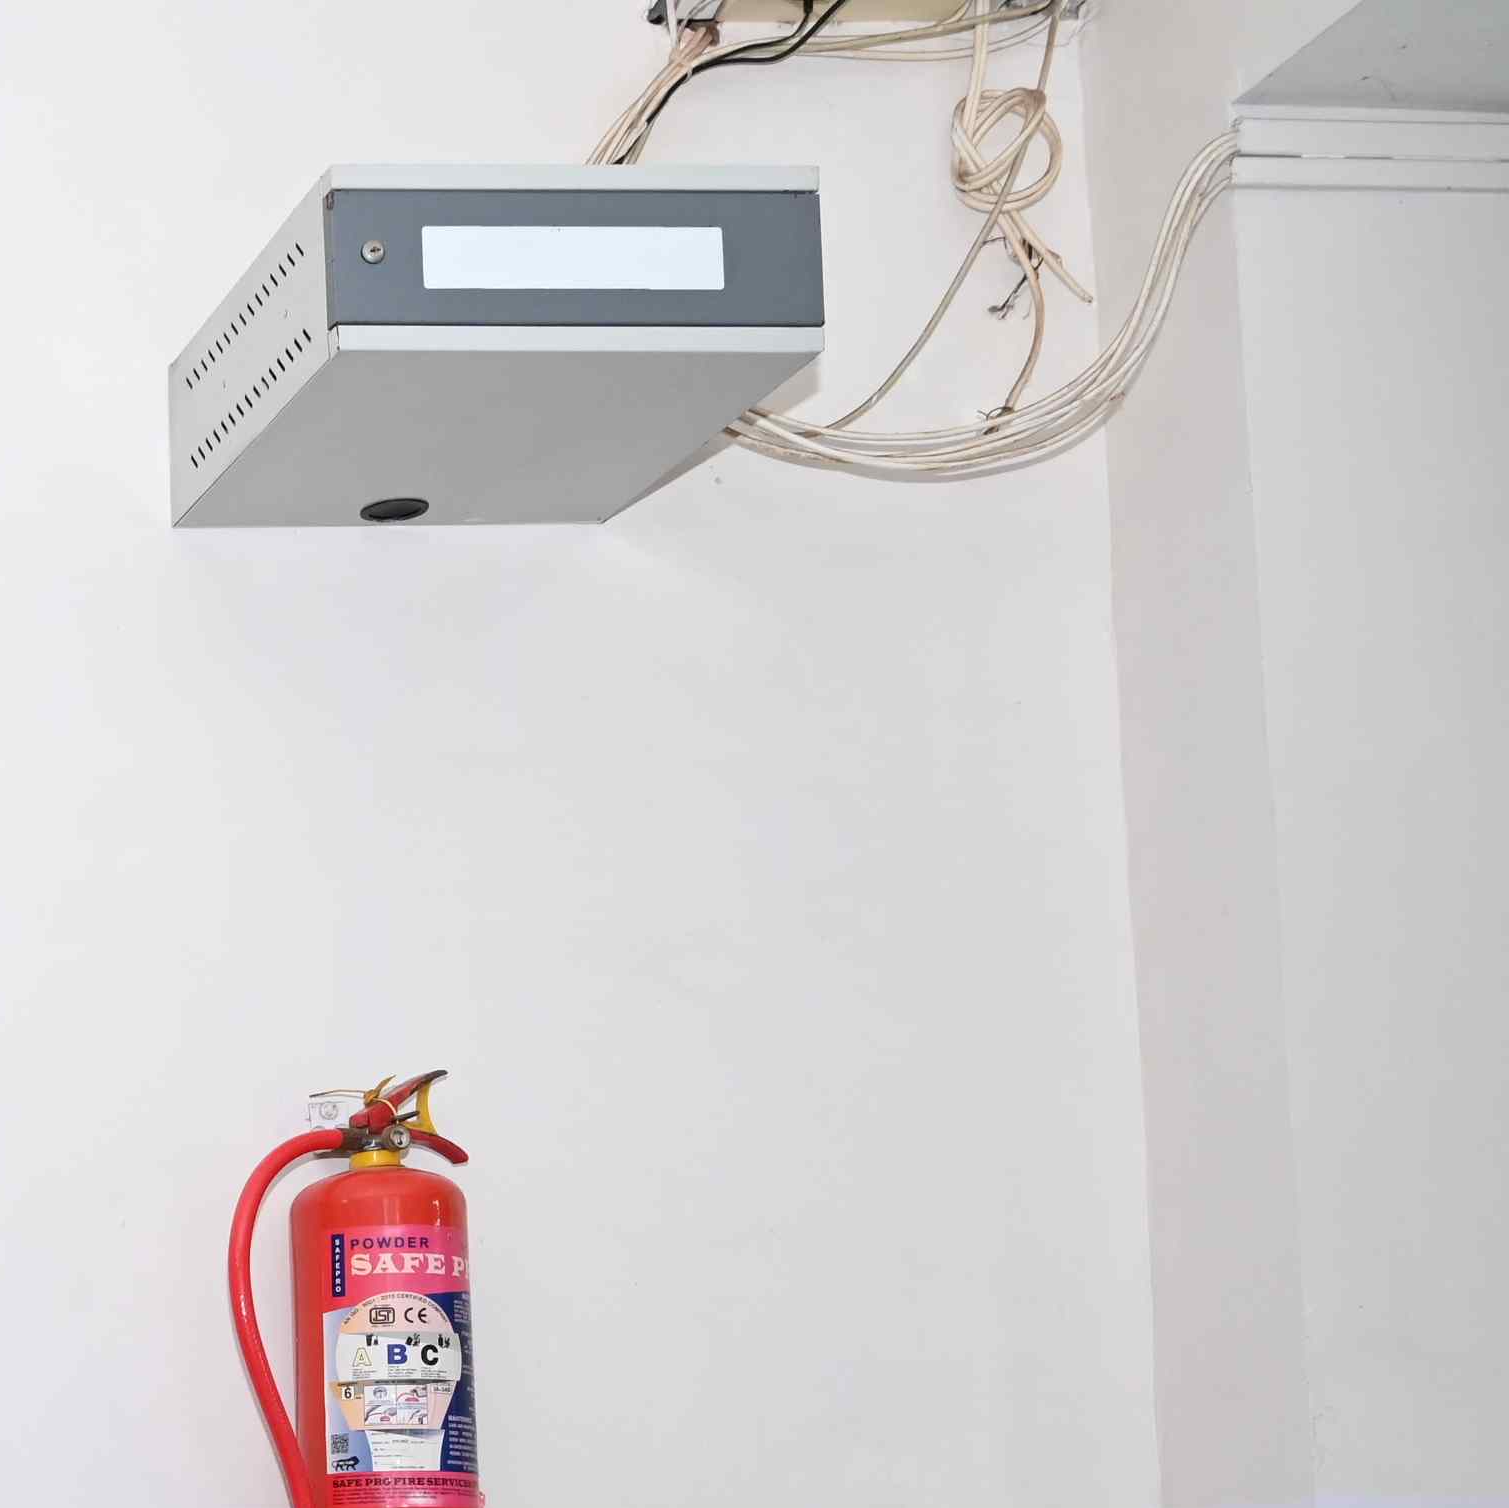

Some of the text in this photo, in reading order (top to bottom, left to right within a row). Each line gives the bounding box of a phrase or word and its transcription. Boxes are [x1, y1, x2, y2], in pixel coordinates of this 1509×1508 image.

[350, 1237, 430, 1250] POWDER
[334, 1239, 342, 1293] SAFEPRO
[350, 1252, 446, 1276] SAFE
[403, 1307, 428, 1323] CE
[352, 1344, 439, 1367] A B C
[344, 1387, 352, 1399] 6
[333, 1478, 363, 1488] SAFE
[394, 1477, 425, 1486] FIRE
